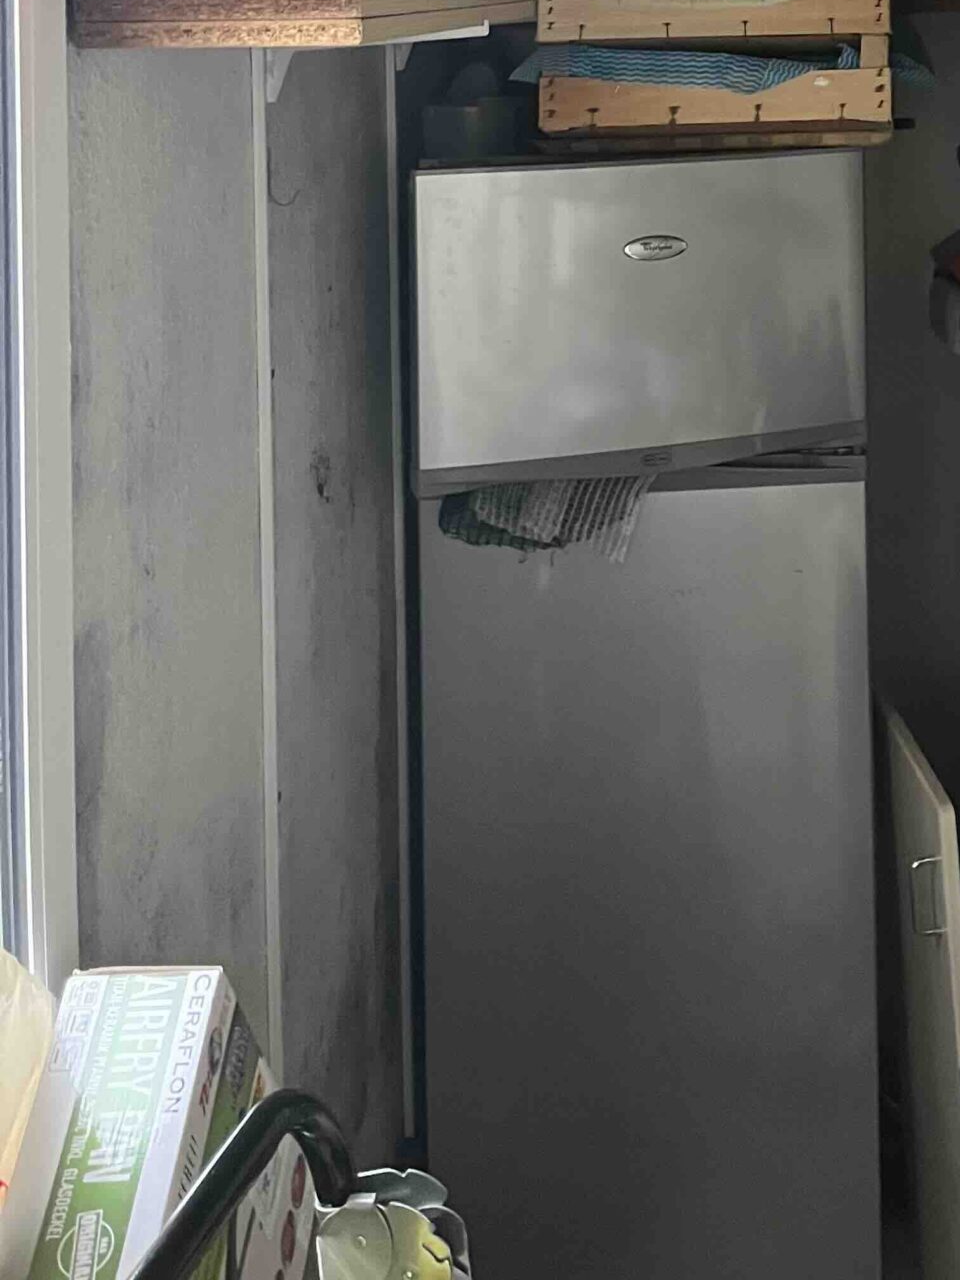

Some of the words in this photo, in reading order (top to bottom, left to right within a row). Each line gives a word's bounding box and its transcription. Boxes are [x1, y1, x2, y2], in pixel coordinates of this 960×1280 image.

[105, 974, 178, 1093] AIRFRY
[164, 973, 212, 1114] CERAFLON
[46, 1167, 79, 1241] GLASDECKEL
